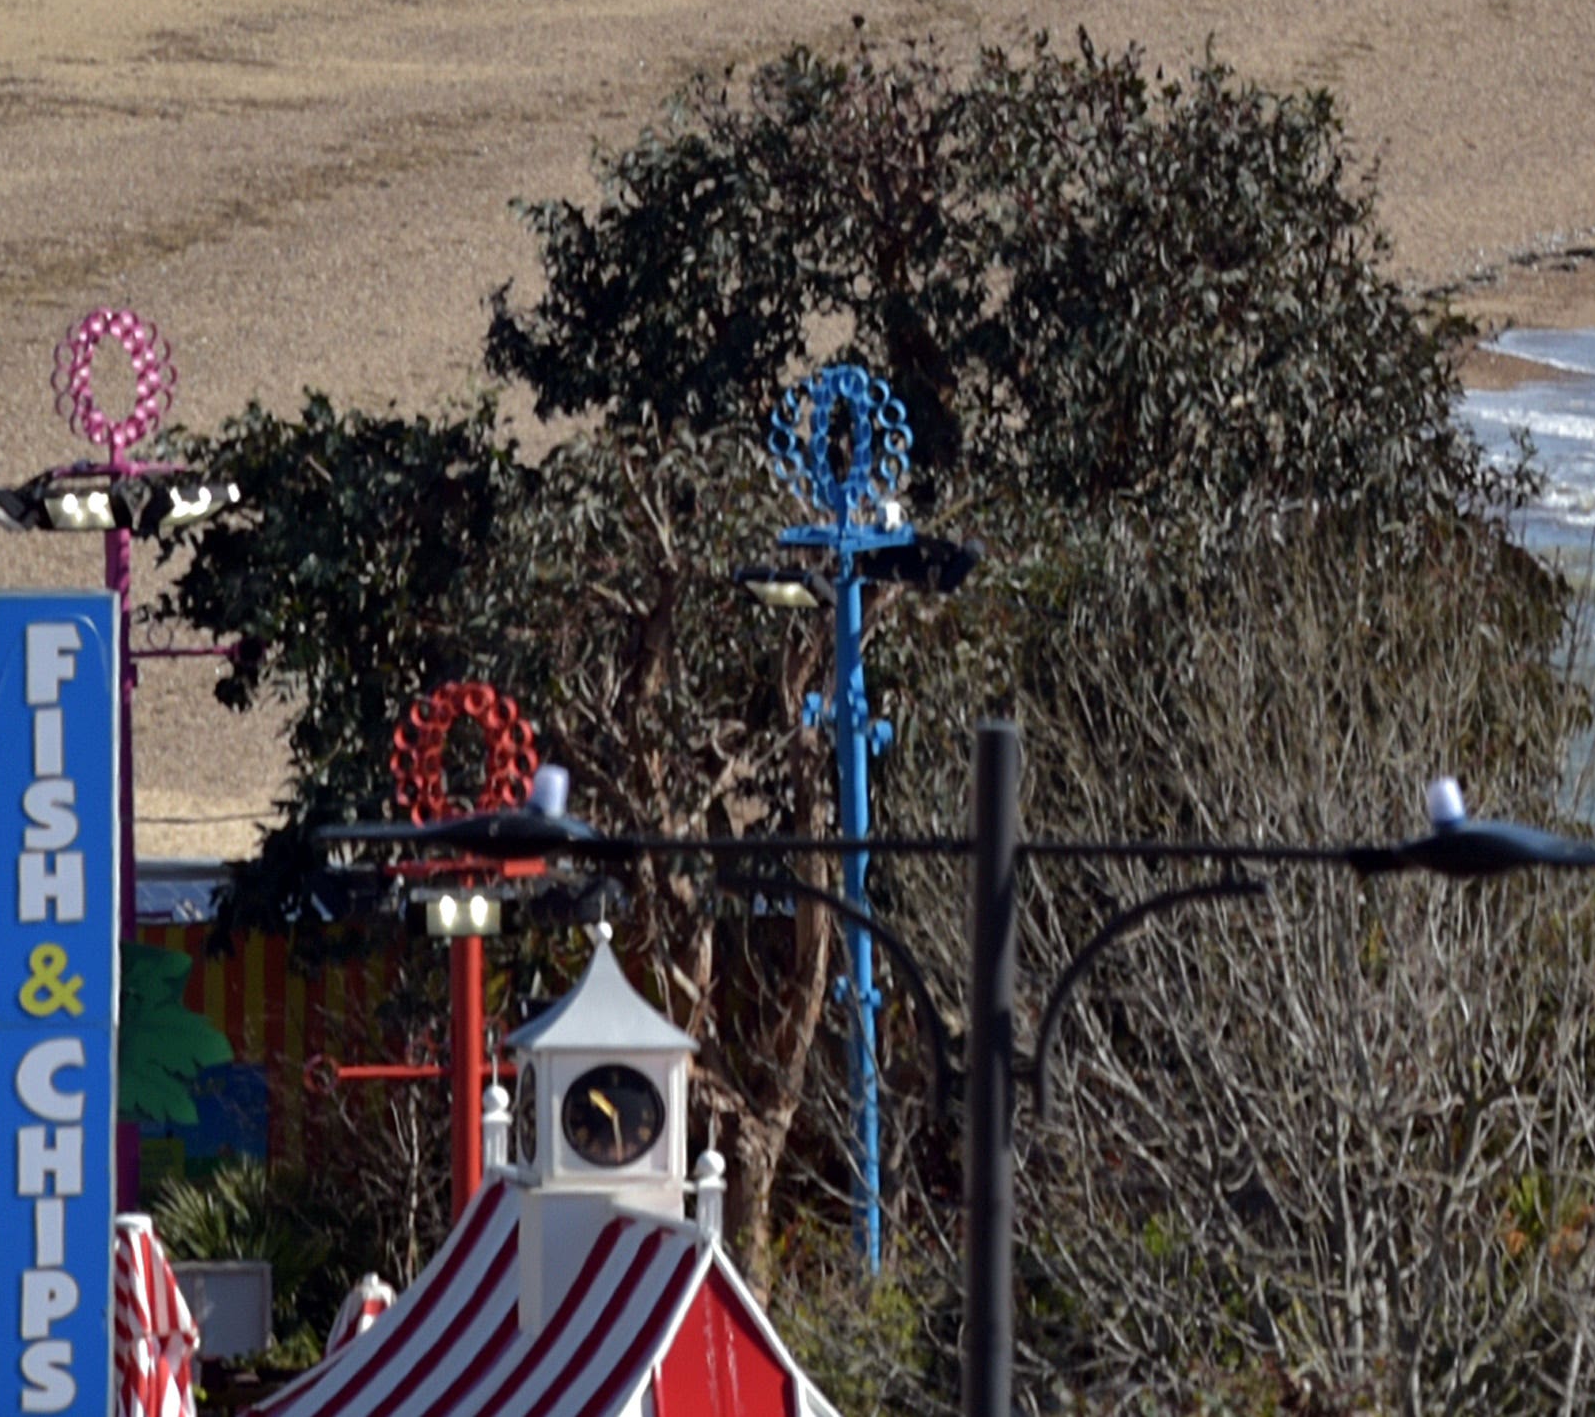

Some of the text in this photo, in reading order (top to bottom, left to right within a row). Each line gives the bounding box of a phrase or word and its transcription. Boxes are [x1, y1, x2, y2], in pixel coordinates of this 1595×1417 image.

[15, 622, 86, 1414] FISH & CHIPS
